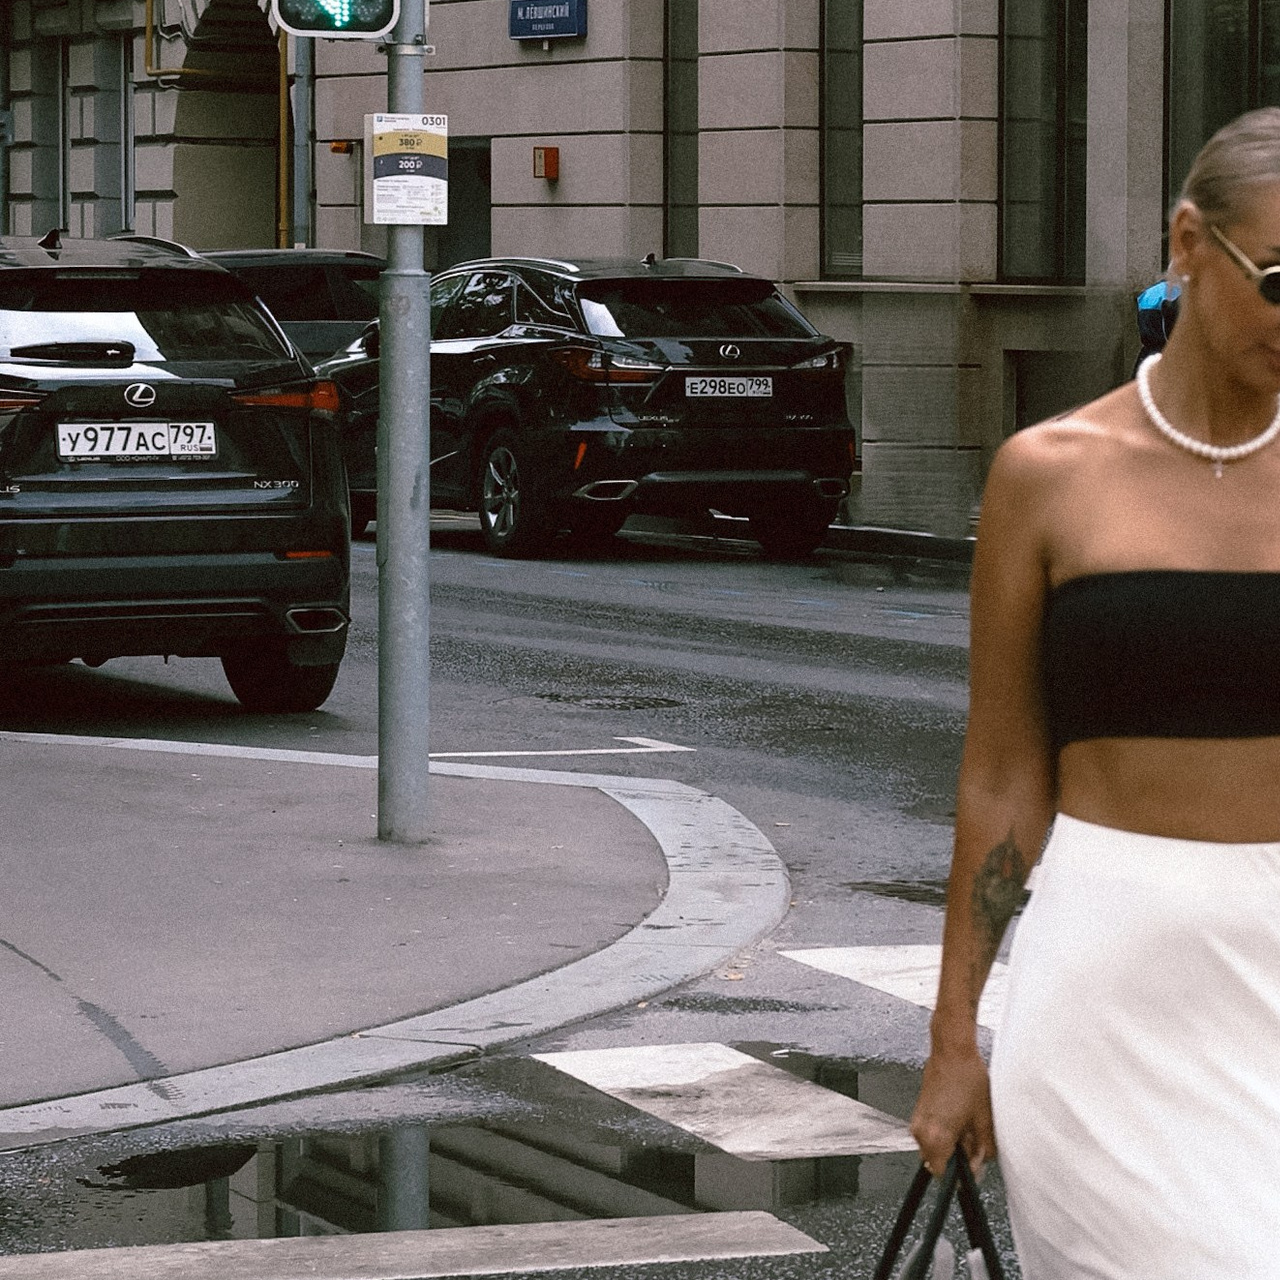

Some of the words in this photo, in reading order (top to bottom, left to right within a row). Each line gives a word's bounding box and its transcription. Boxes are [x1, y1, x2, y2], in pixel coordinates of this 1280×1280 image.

[422, 117, 446, 125] 0301
[748, 378, 769, 390] 799
[170, 425, 206, 444] 797
[180, 444, 200, 452] RUS
